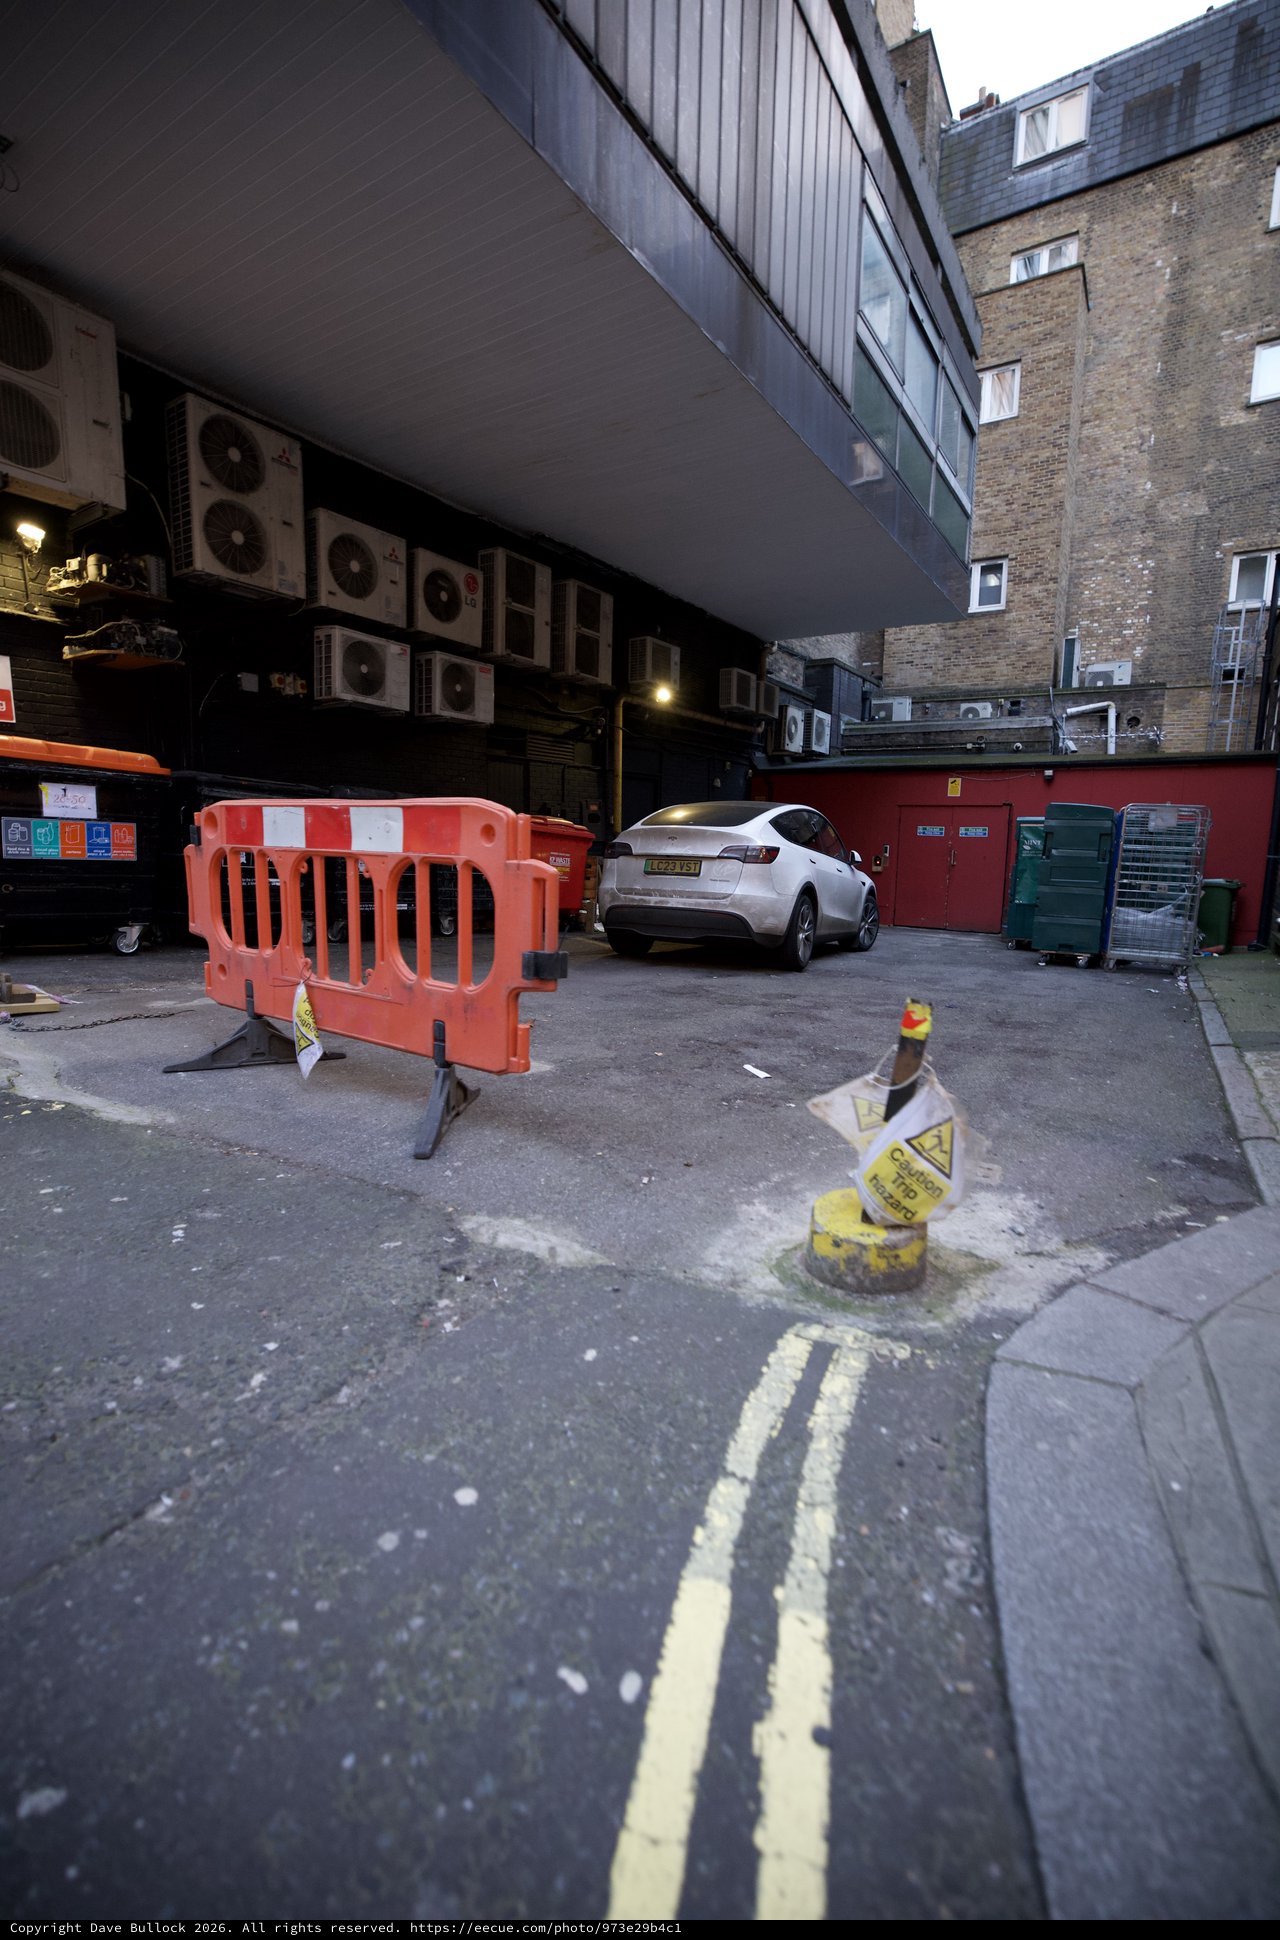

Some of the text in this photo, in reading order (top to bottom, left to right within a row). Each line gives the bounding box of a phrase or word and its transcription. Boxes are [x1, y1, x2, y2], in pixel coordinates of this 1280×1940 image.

[650, 861, 699, 872] LC23 VST
[890, 1148, 944, 1198] Caution
[891, 1171, 918, 1200] Trip
[869, 1173, 917, 1221] hazard
